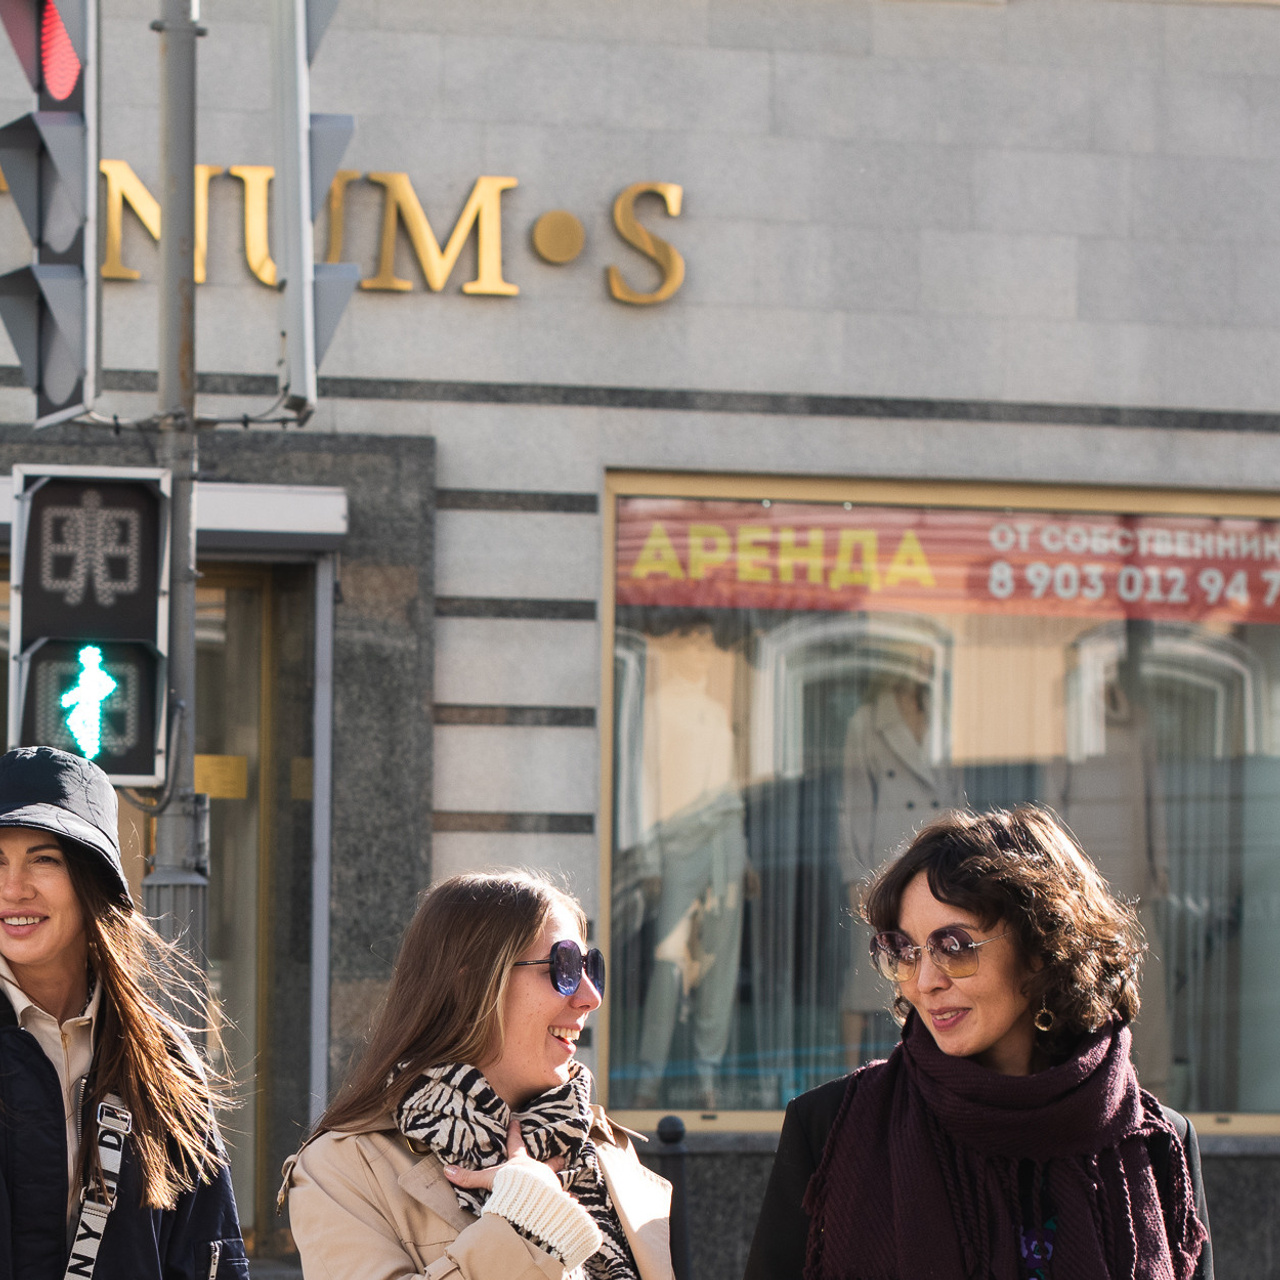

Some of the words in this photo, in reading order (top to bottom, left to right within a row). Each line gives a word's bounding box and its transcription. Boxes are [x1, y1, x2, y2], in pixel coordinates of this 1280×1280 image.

[631, 523, 936, 592] АРЕНДА
[989, 523, 1033, 552] ОТ
[989, 561, 1014, 599] 8
[1025, 561, 1104, 599] 903
[1118, 564, 1188, 603] 012
[1198, 567, 1248, 606] 94
